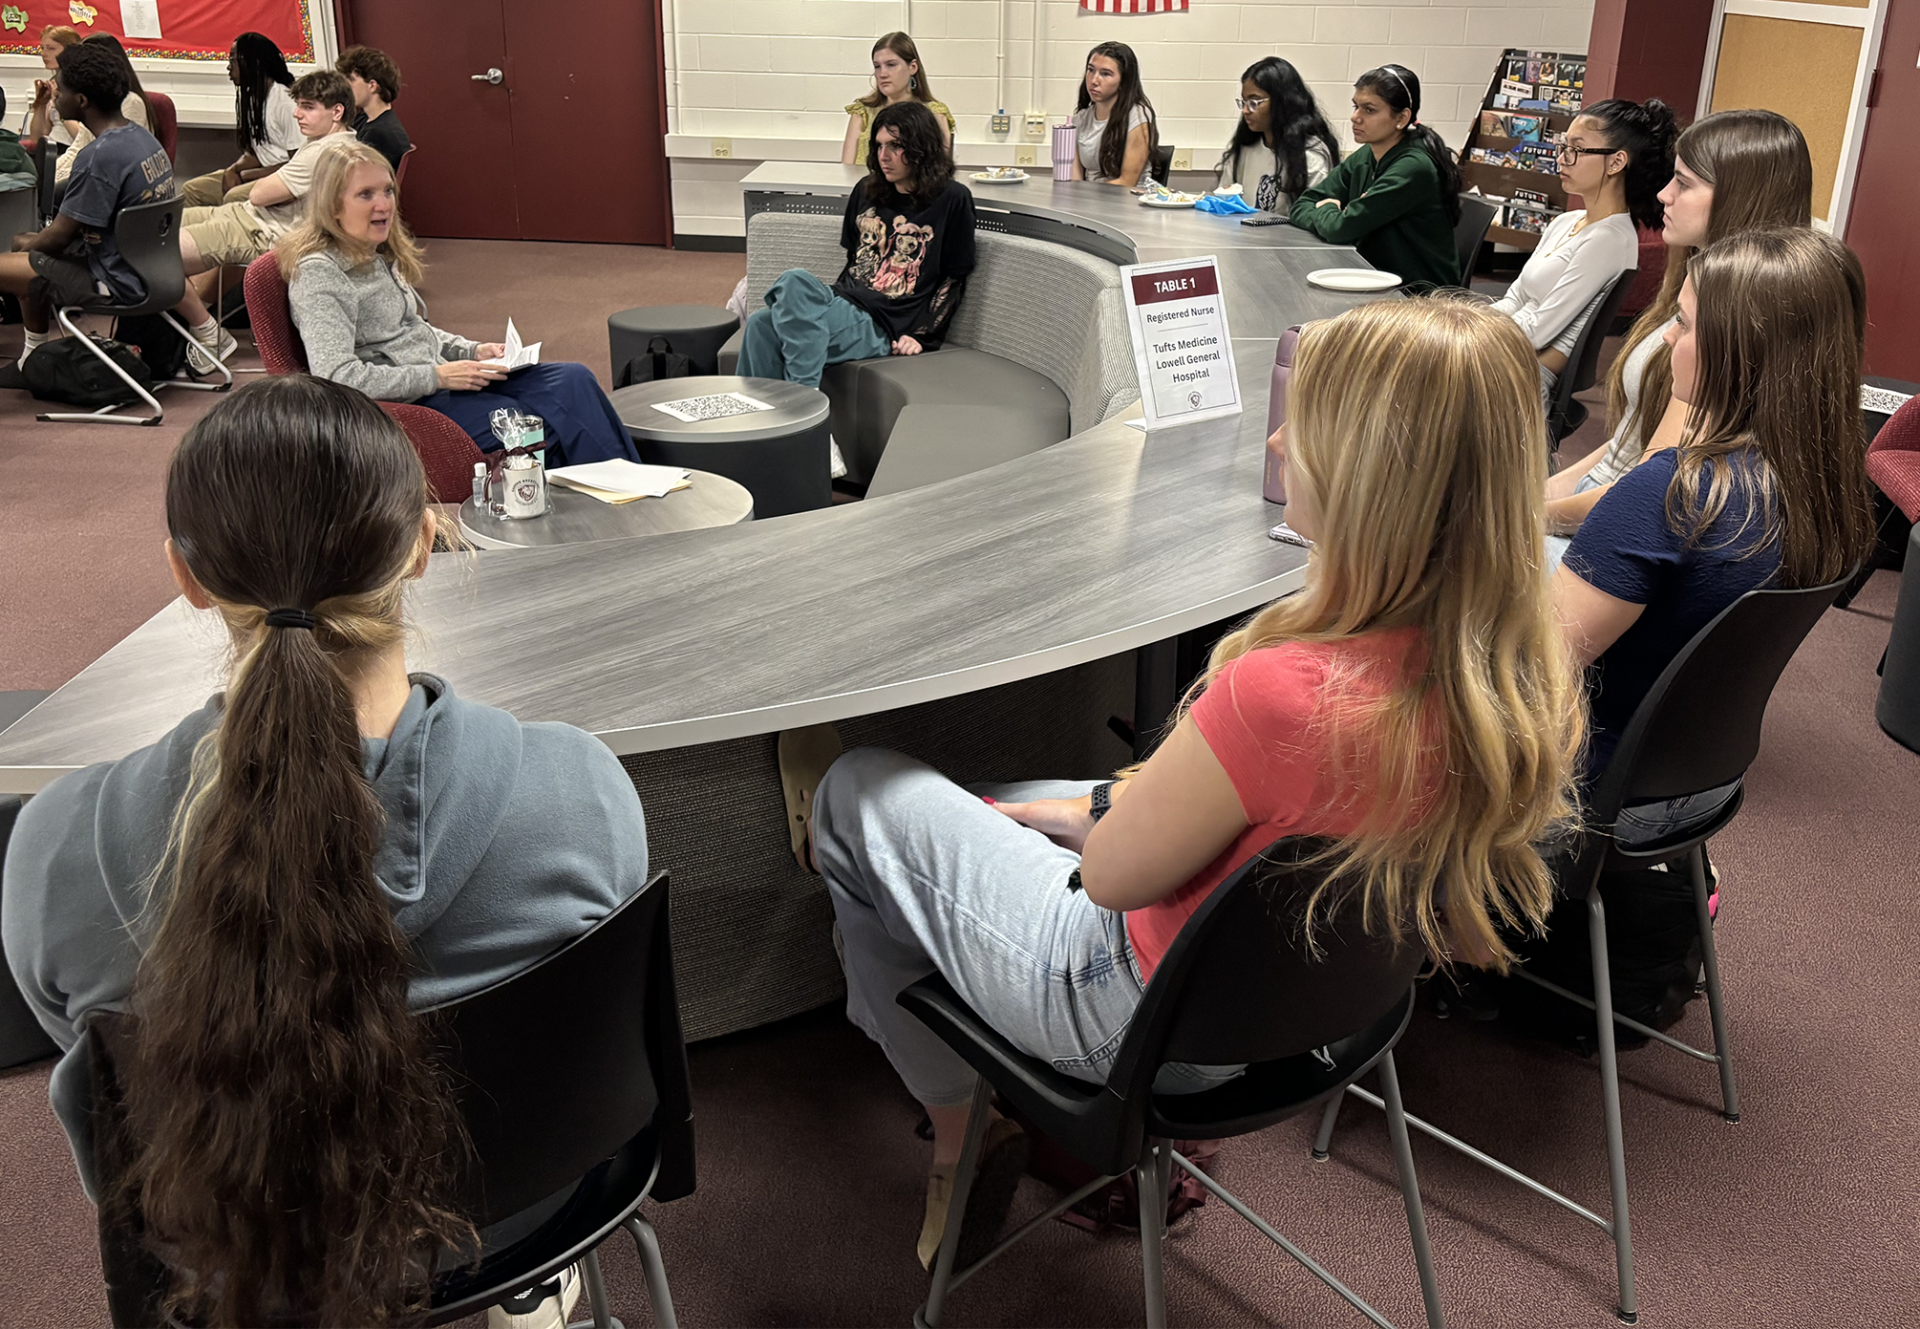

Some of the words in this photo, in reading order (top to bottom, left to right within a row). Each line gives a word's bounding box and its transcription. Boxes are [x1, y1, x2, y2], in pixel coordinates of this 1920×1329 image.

[1154, 279, 1188, 293] TABLE
[1189, 277, 1196, 289] 1
[1147, 309, 1190, 324] Registered
[1190, 305, 1215, 317] Nurse
[1153, 342, 1177, 354] Tufts
[1177, 335, 1218, 350] Medicine
[1156, 356, 1186, 370] Lowell
[1186, 350, 1220, 364] General
[1172, 369, 1210, 383] Hospital
